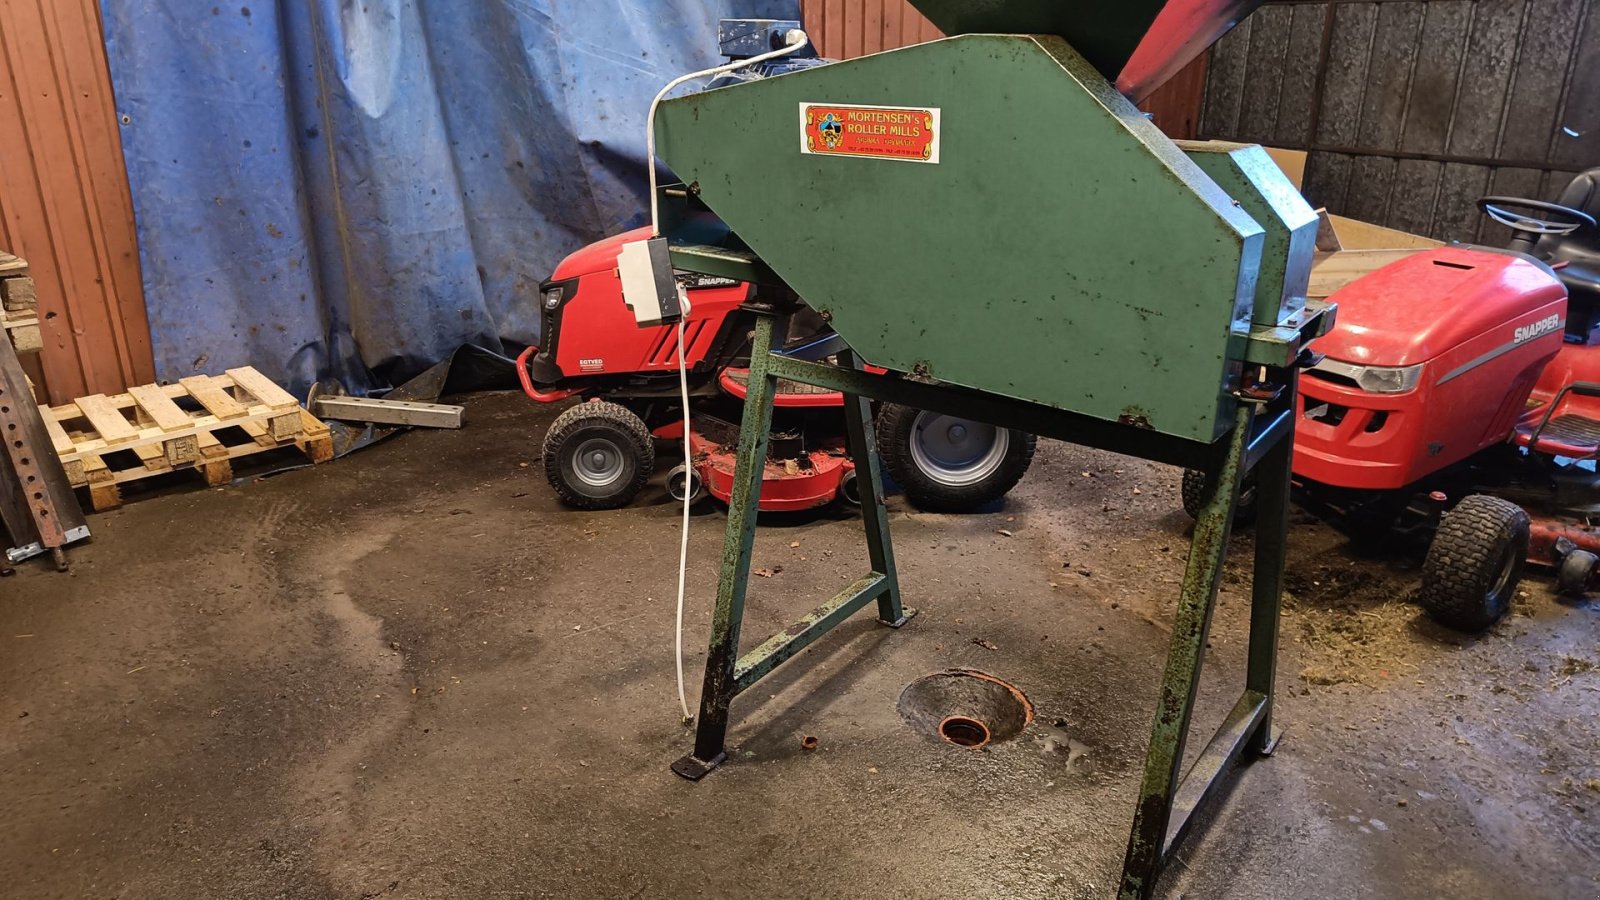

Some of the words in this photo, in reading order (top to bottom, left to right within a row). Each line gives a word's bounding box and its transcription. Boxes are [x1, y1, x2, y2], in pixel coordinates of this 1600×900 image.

[848, 112, 920, 125] MORTENSEN's
[848, 124, 886, 135] ROLLER
[889, 126, 920, 137] MILLS
[1513, 313, 1559, 344] SNAPPER
